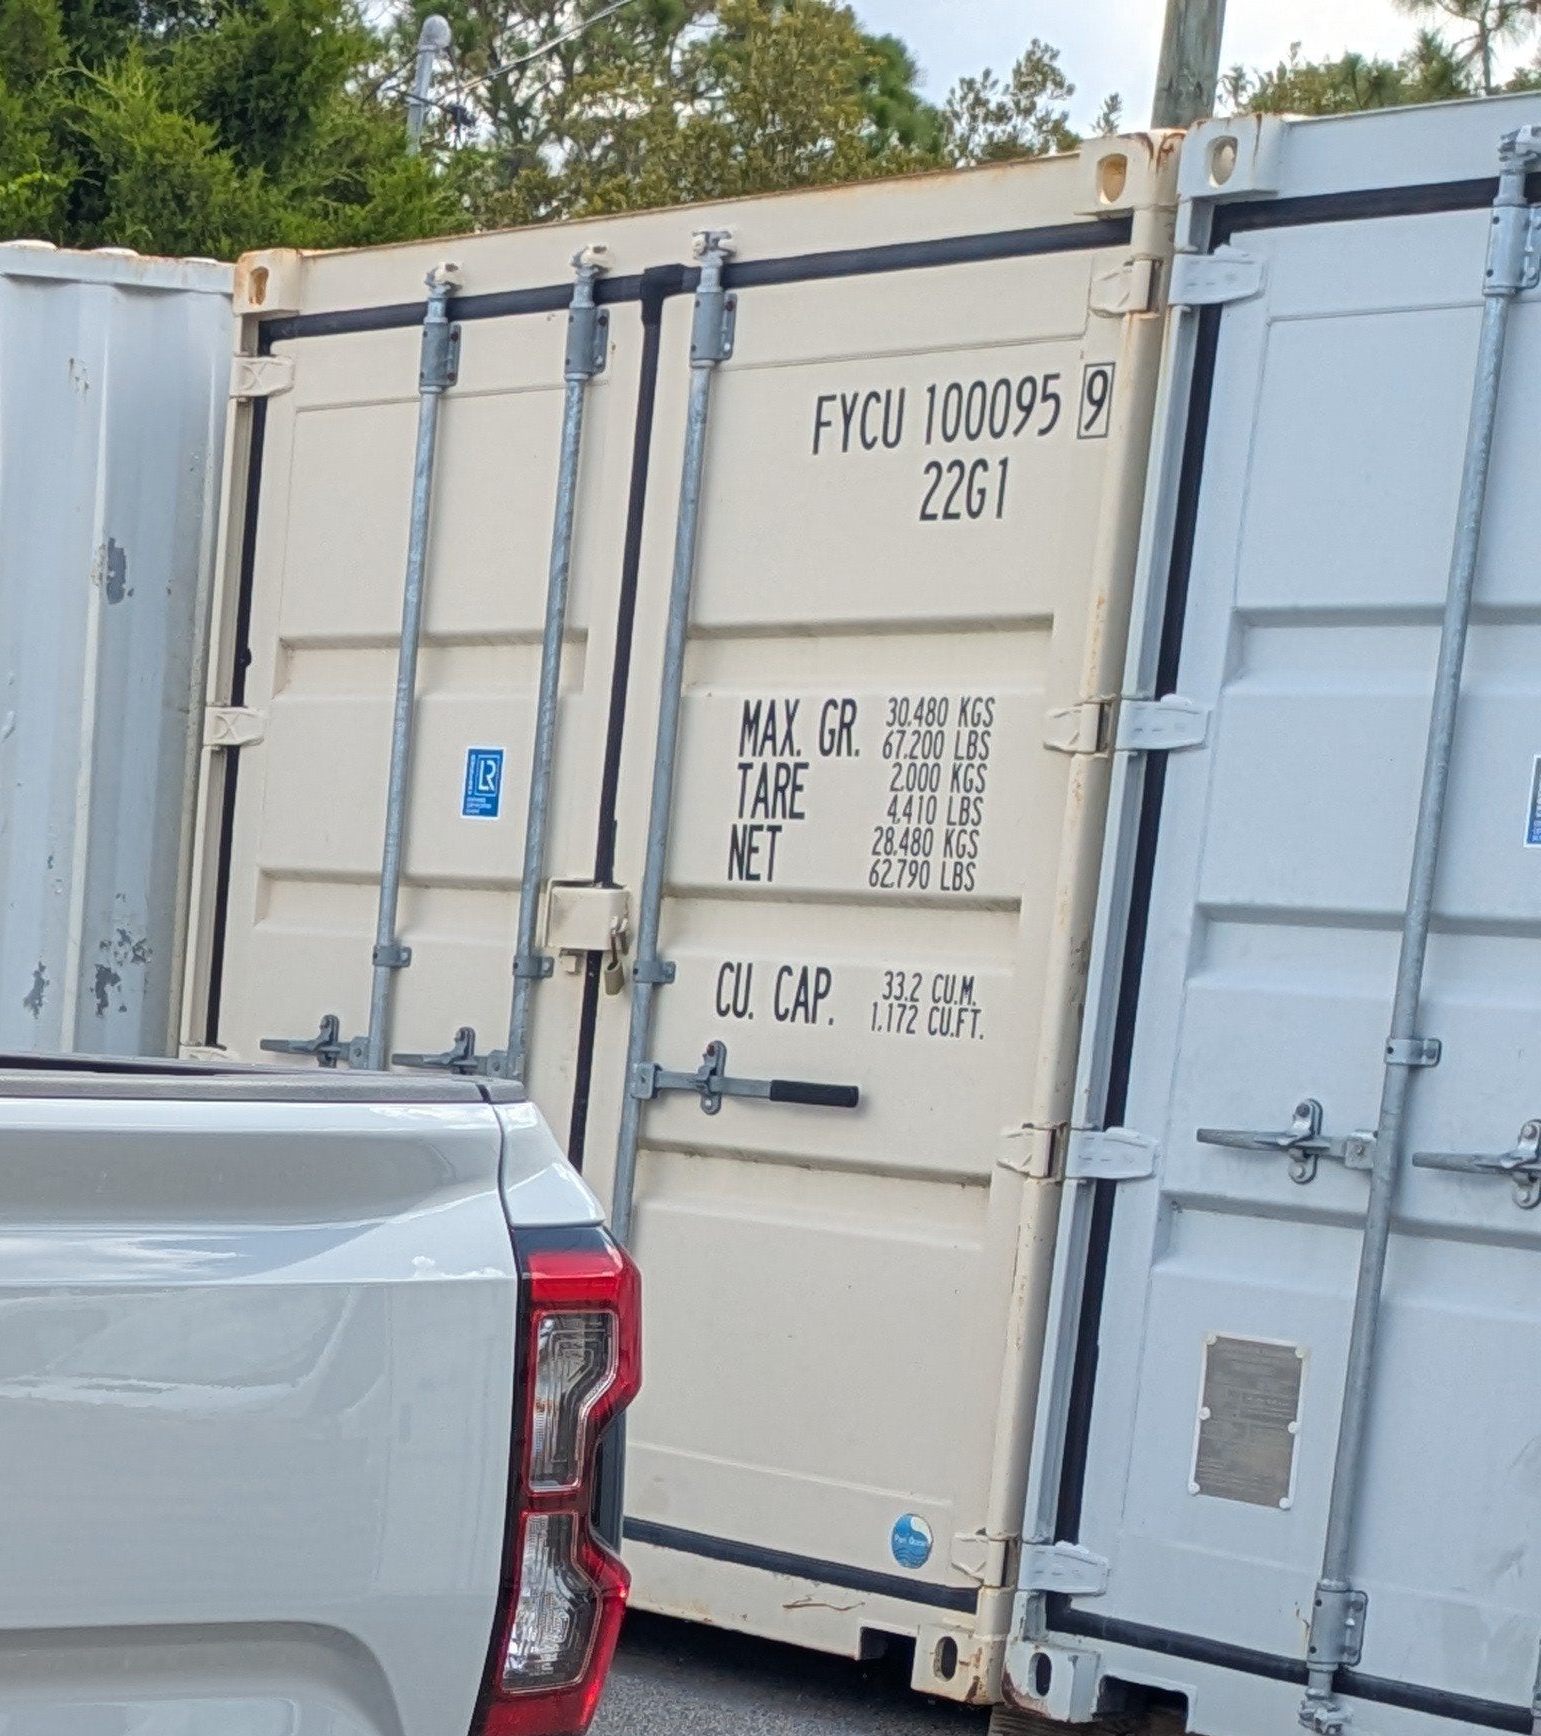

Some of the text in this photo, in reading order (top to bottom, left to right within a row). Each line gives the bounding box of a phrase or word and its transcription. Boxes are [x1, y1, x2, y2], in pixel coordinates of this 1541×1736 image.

[812, 368, 1109, 455] FYCU 100095 9
[919, 456, 1010, 522] 22G1
[738, 696, 996, 758] MAX. GR. 30.480 KGS
[881, 729, 992, 760] 67.200 LBS
[478, 760, 497, 791] LR
[737, 761, 988, 820] TARE 2.000 KGS
[887, 794, 984, 827] 4.410 LBS
[727, 823, 980, 882] NET 28.480 KGS
[868, 858, 977, 893] 62.790 LBS
[716, 961, 977, 1026] CU. CAP. 33.2 CU.M.
[870, 1001, 984, 1040] 1.172 CU.FT.
